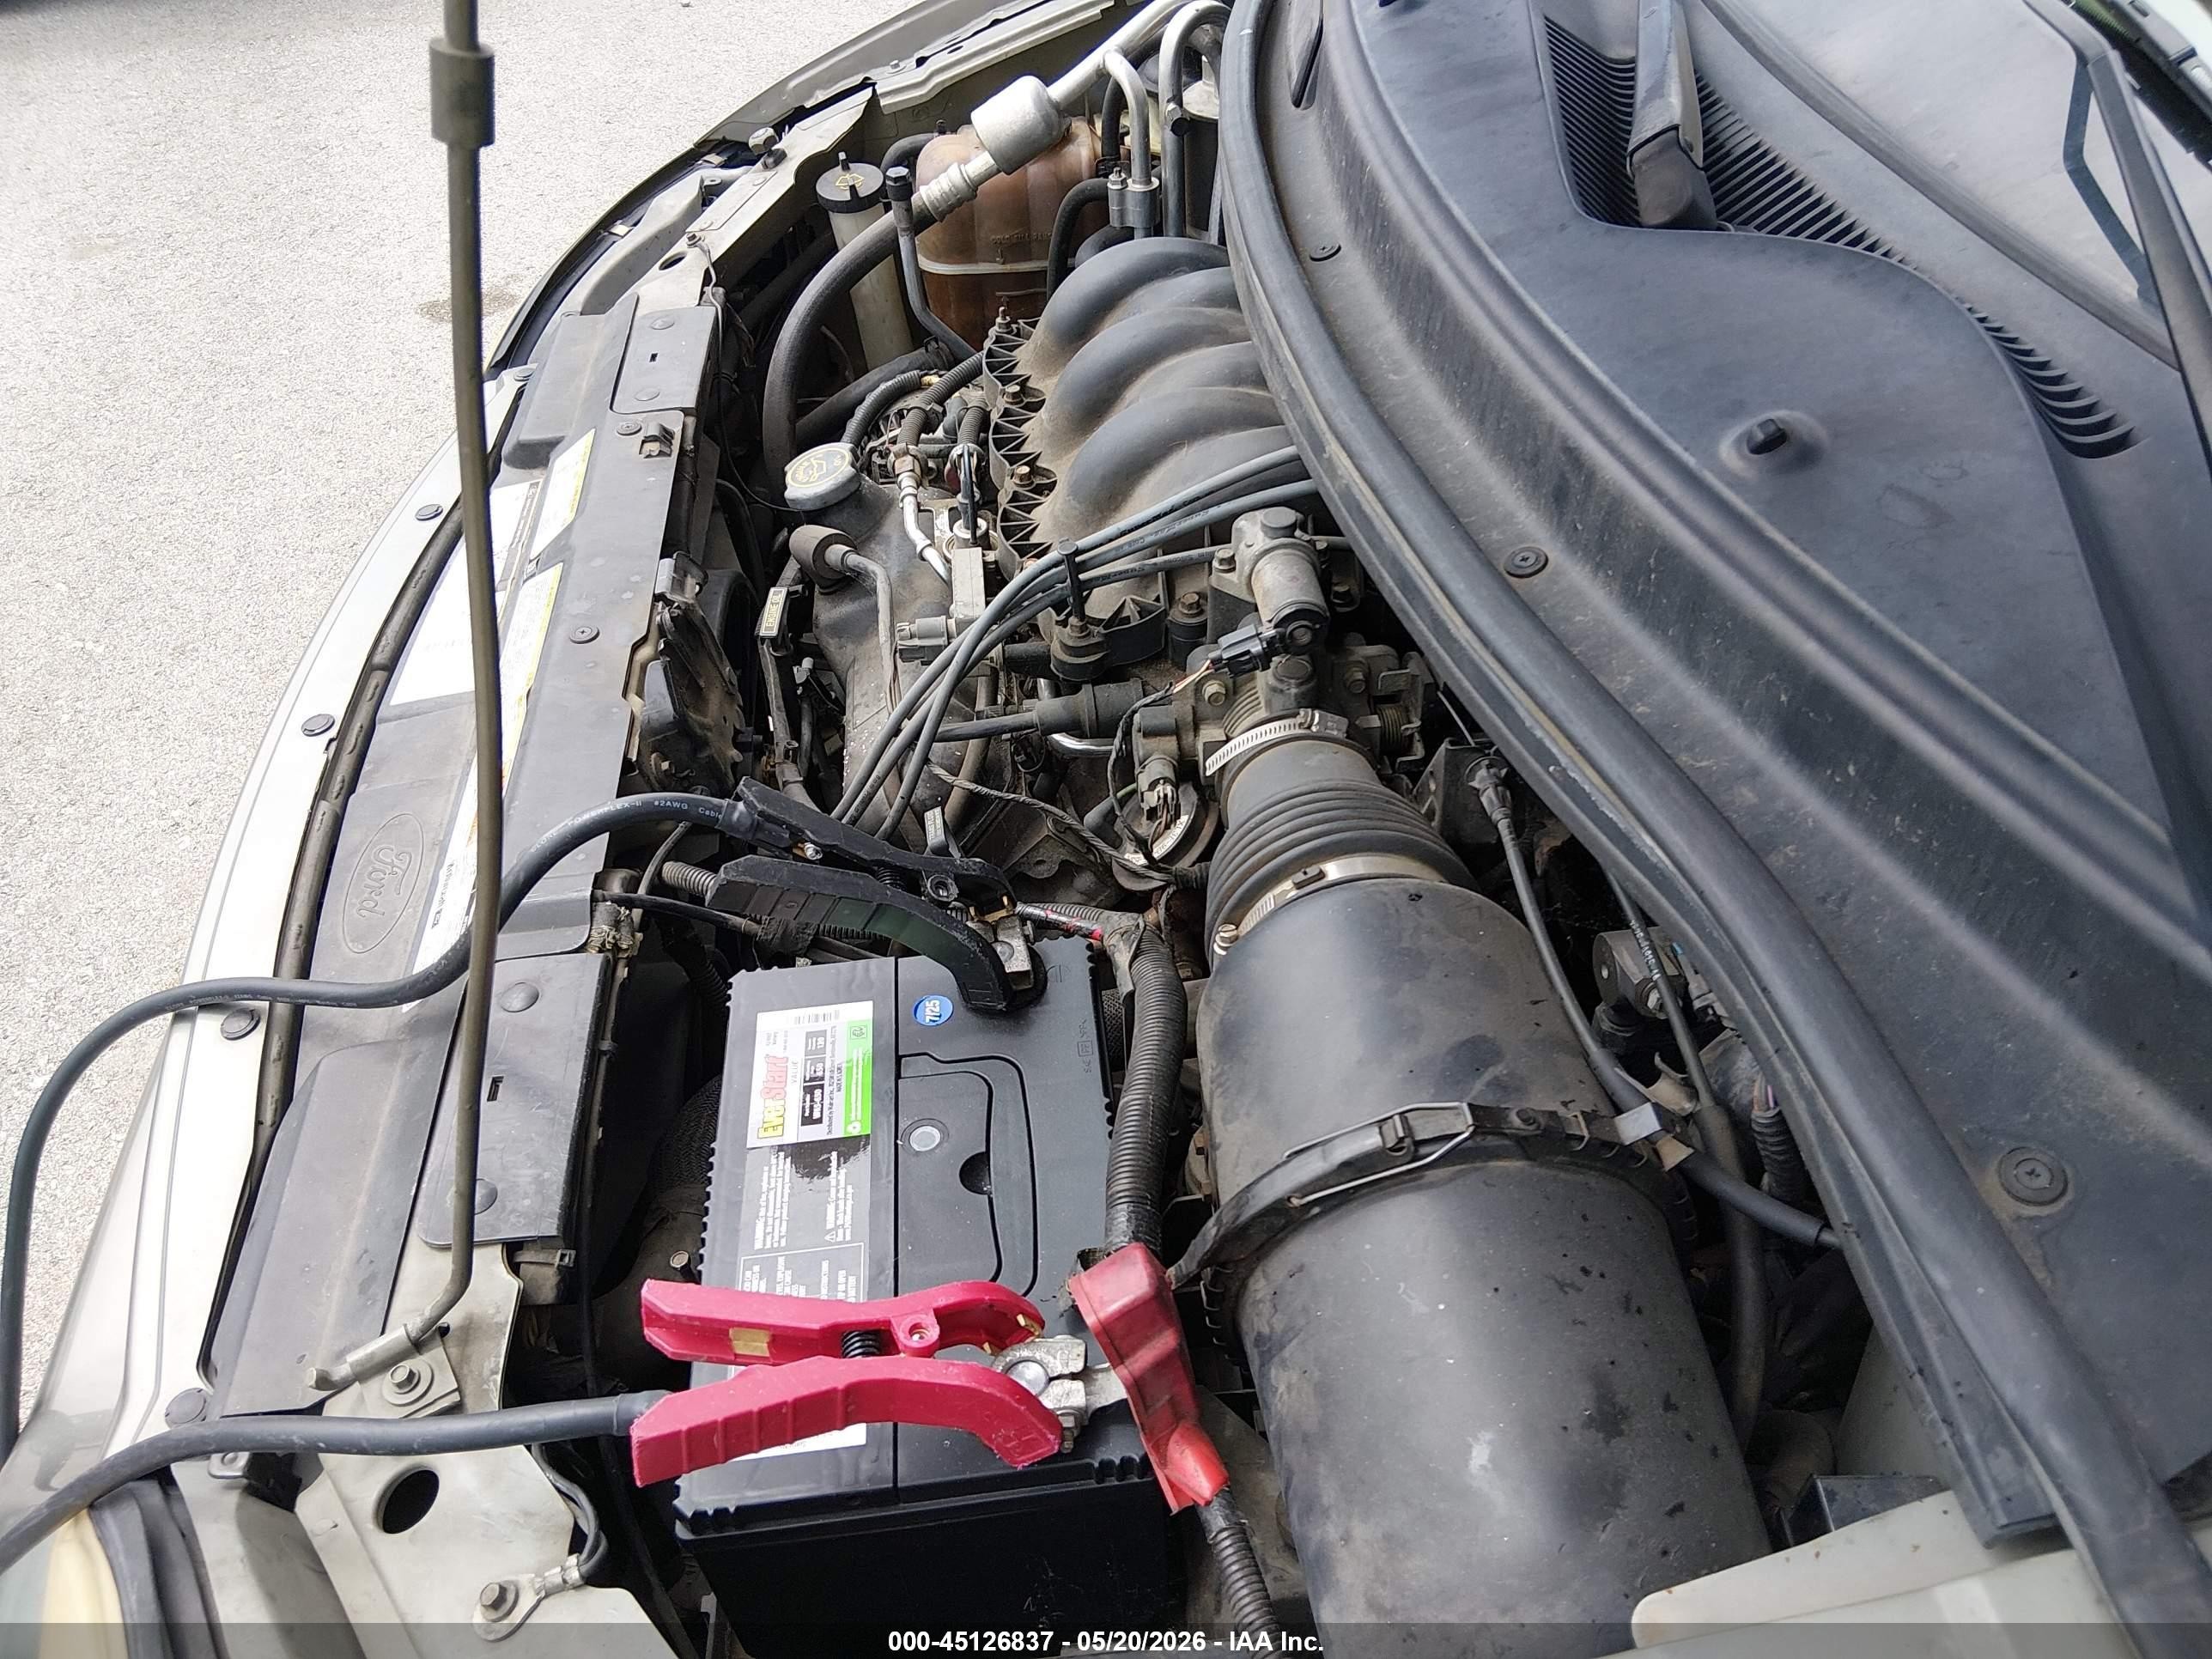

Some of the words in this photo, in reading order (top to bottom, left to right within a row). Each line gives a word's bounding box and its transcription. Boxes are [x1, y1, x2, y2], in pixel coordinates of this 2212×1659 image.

[771, 593, 782, 603] OIL
[766, 604, 778, 627] ENGINE
[356, 845, 412, 918] Ford
[925, 1000, 940, 1023] 7/25
[757, 1056, 789, 1139] EverStart
